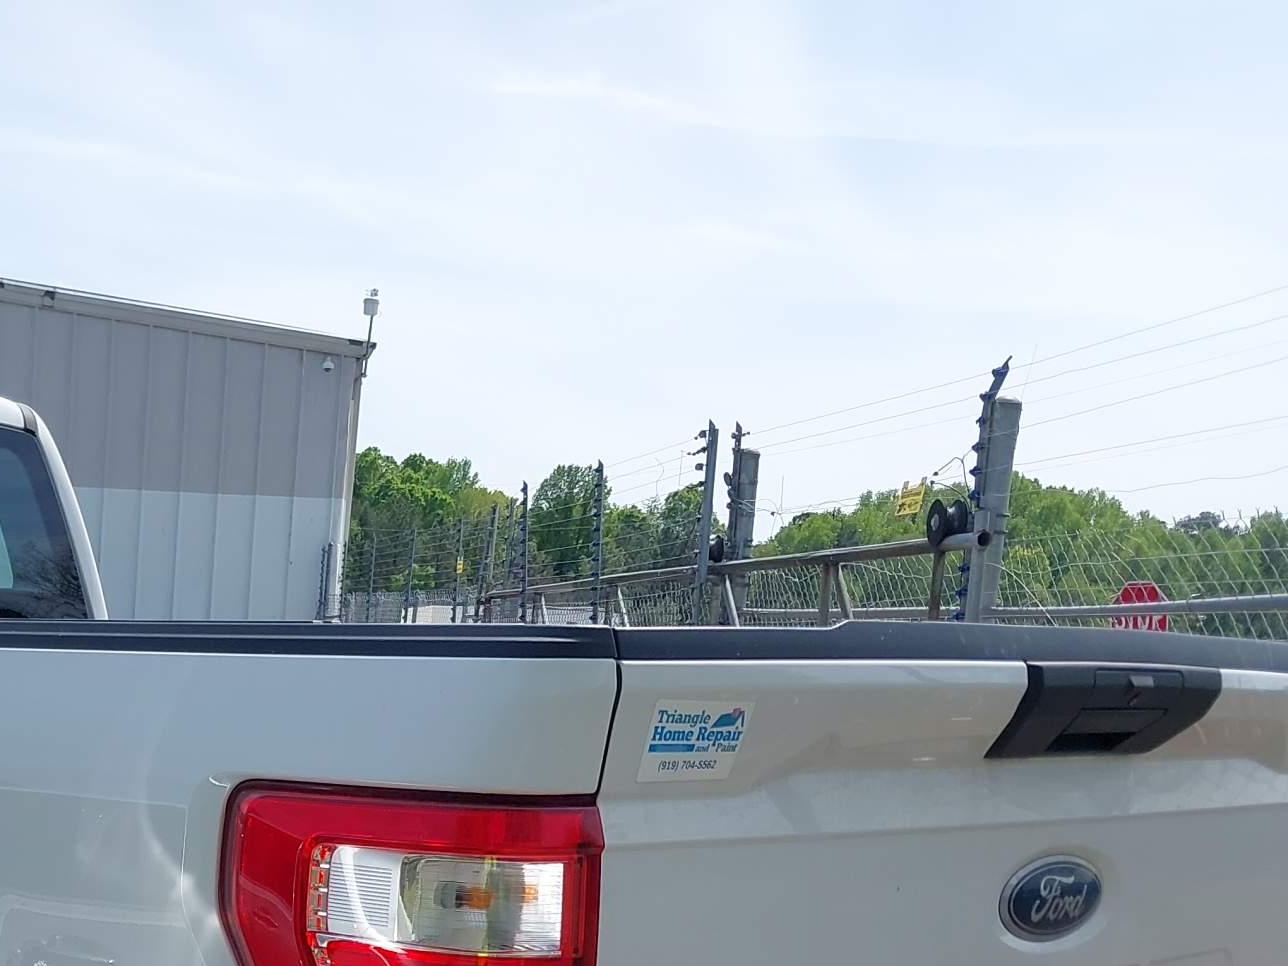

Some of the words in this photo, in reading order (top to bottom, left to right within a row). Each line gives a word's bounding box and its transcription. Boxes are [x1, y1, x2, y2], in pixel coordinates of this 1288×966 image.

[658, 709, 712, 727] Triangle
[651, 726, 694, 742] Home
[696, 727, 743, 747] Repair
[695, 743, 710, 753] and
[715, 743, 738, 753] Paint
[657, 760, 679, 773] (919)
[1030, 875, 1088, 923] Ford
